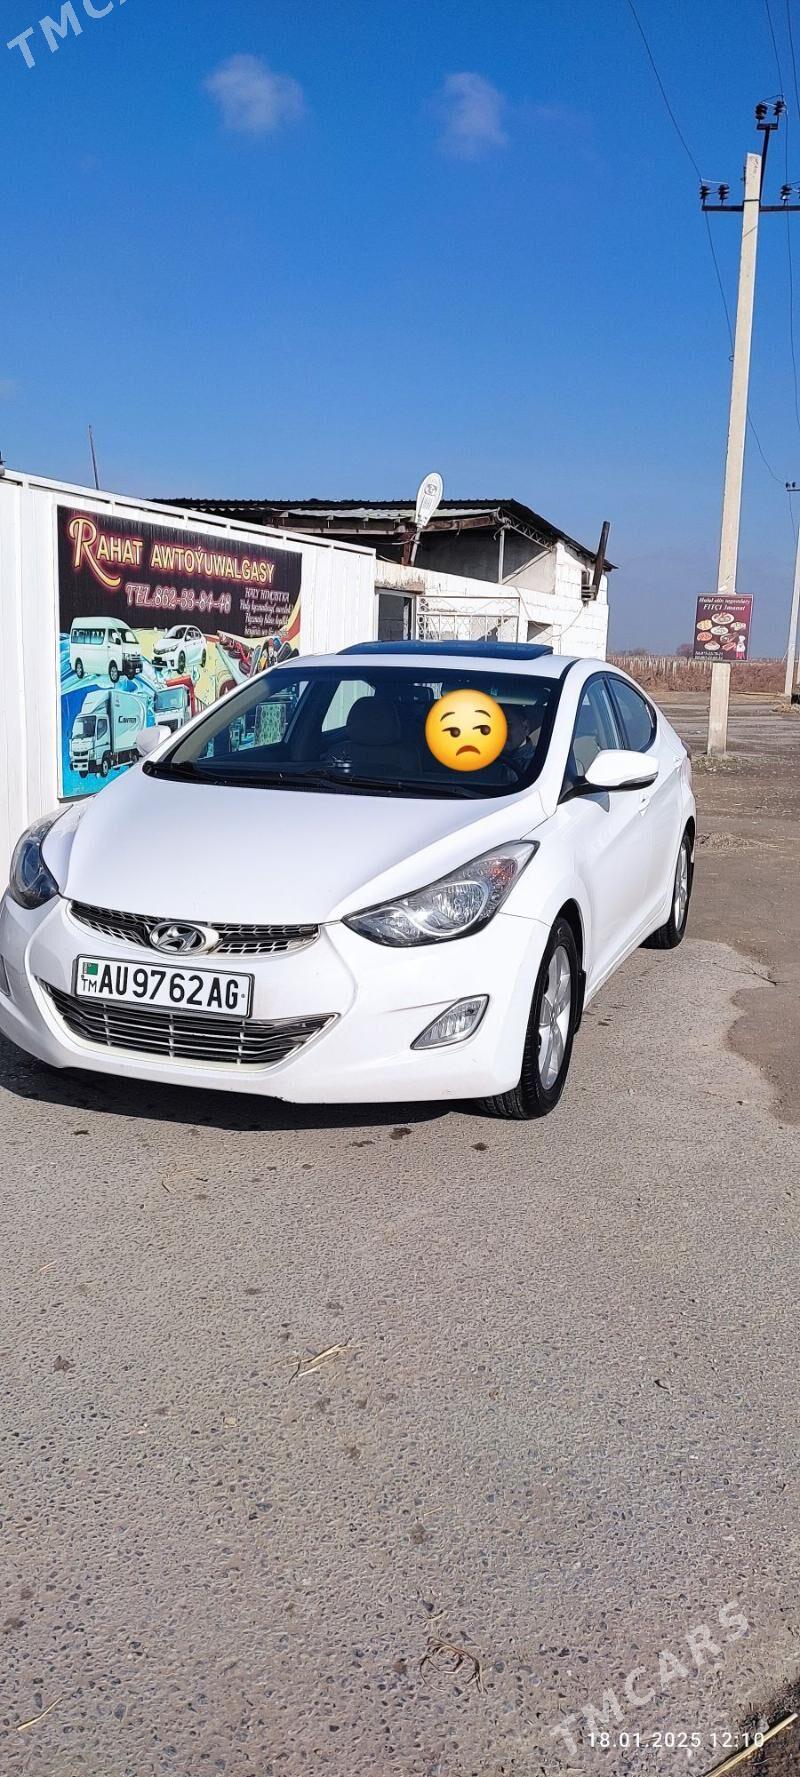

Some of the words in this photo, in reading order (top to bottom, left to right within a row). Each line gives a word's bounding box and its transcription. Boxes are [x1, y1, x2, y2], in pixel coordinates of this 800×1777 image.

[151, 546, 275, 583] AWTOÝUWALGASY
[82, 978, 97, 993] TM
[99, 964, 239, 1010] AU9762AG
